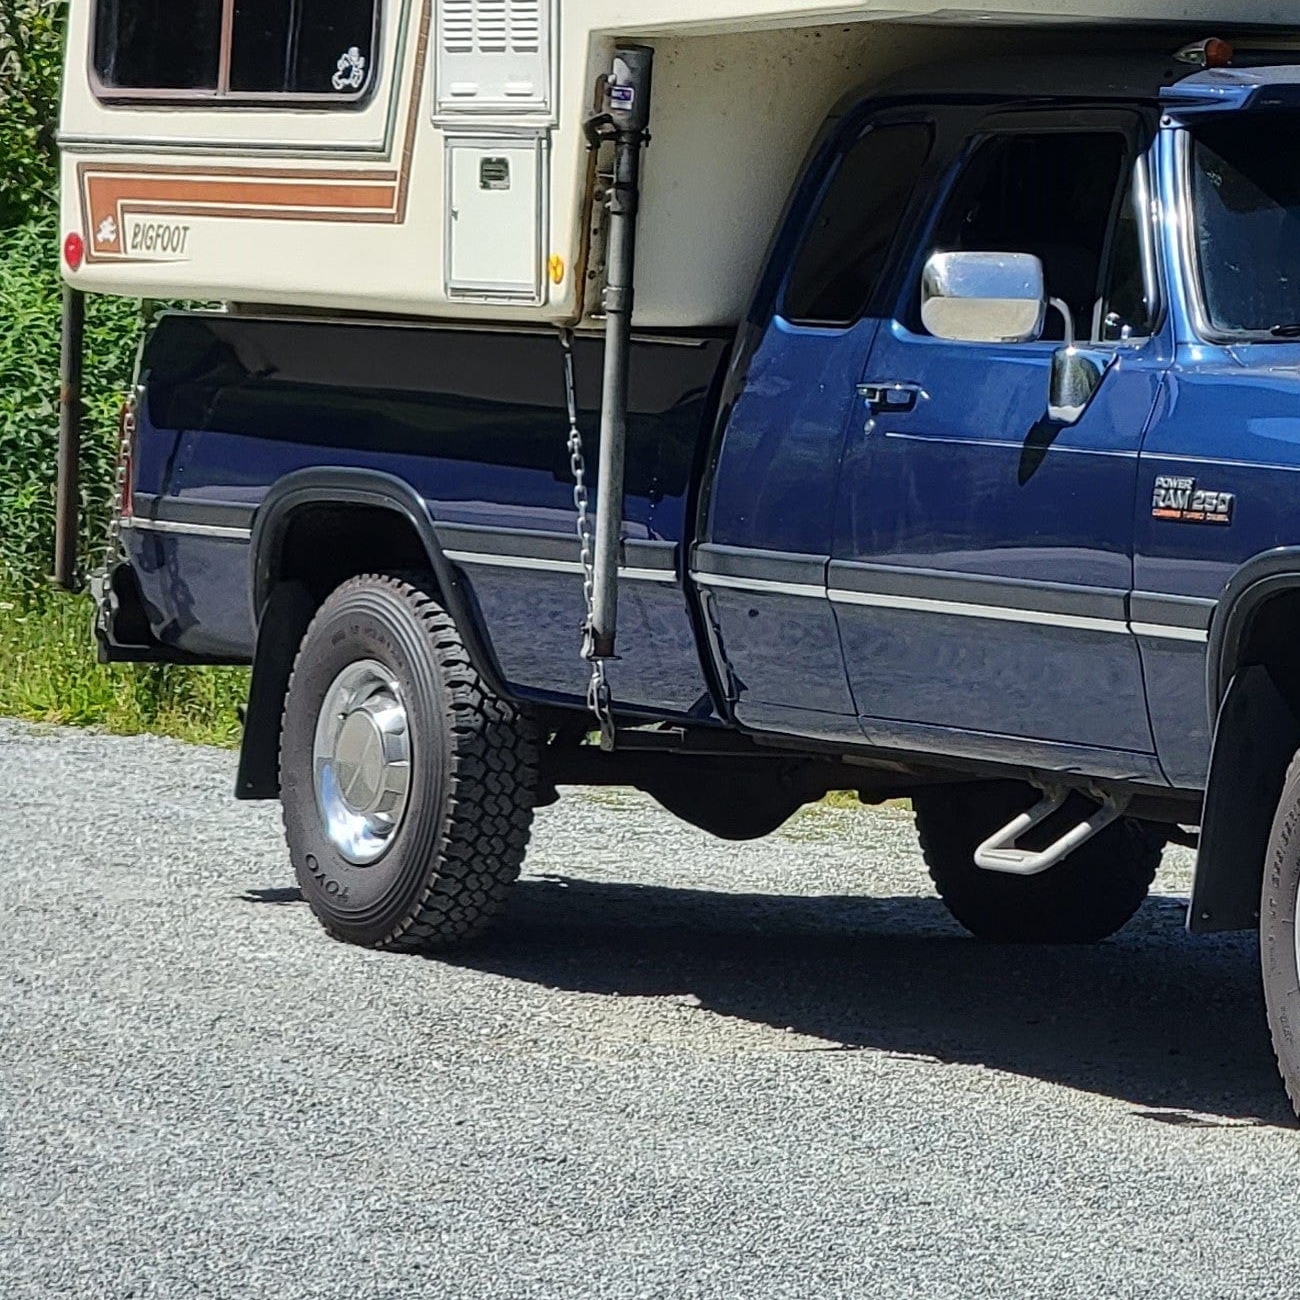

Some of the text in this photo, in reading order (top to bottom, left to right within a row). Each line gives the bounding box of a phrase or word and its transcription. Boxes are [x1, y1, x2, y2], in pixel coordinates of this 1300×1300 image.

[131, 223, 190, 253] BIGFOOT
[1155, 477, 1194, 489] POWER
[1152, 488, 1232, 512] RAM 250
[305, 854, 351, 903] TOYO
